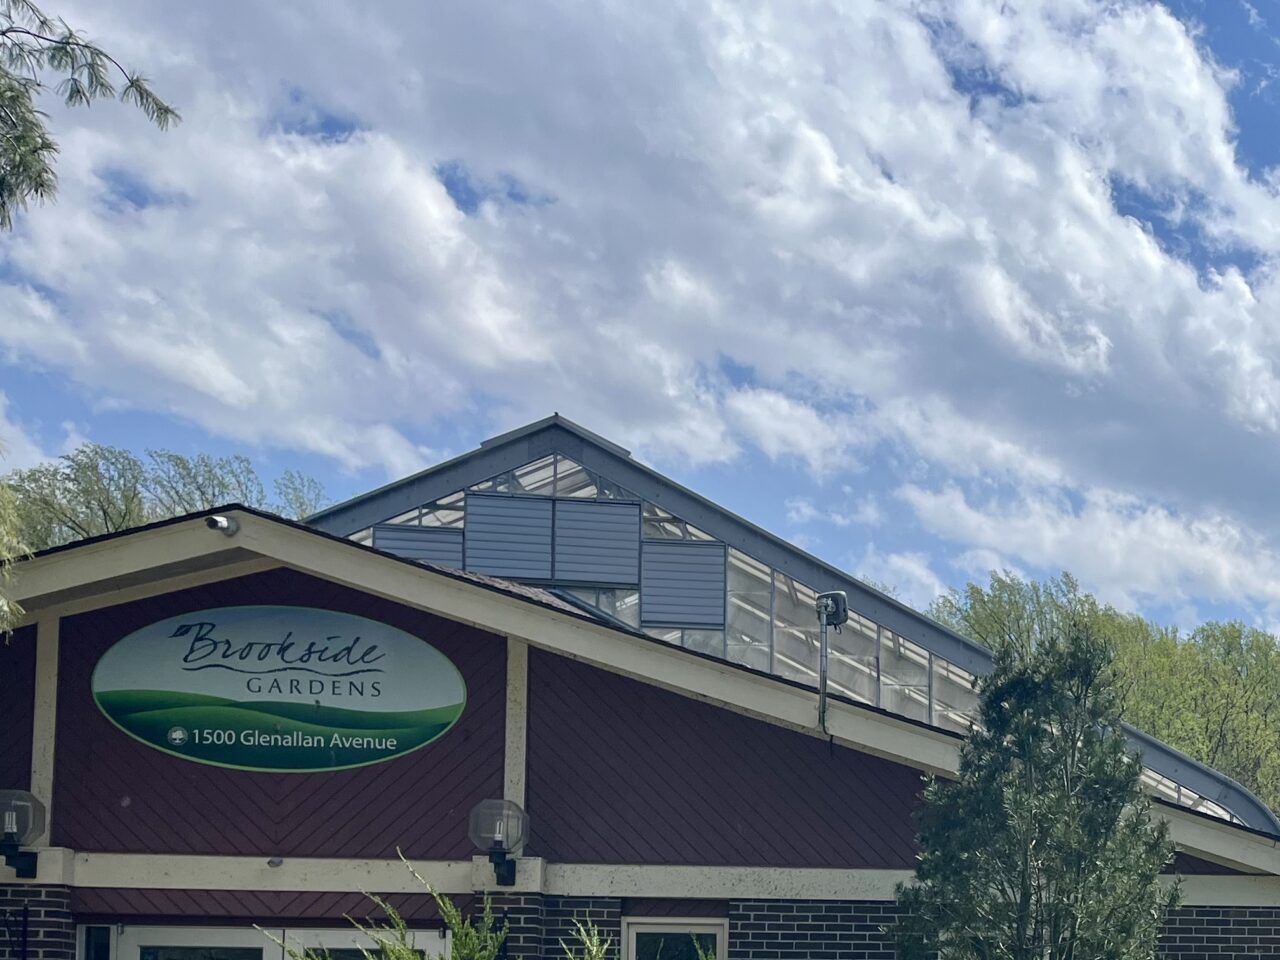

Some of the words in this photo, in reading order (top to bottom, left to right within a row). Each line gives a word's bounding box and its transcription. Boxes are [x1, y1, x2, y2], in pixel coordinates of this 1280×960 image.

[178, 622, 386, 665] Brookside
[246, 677, 382, 698] GARDENS
[192, 729, 236, 745] 1500
[240, 730, 325, 748] Glenallan
[329, 733, 397, 750] Avenue
